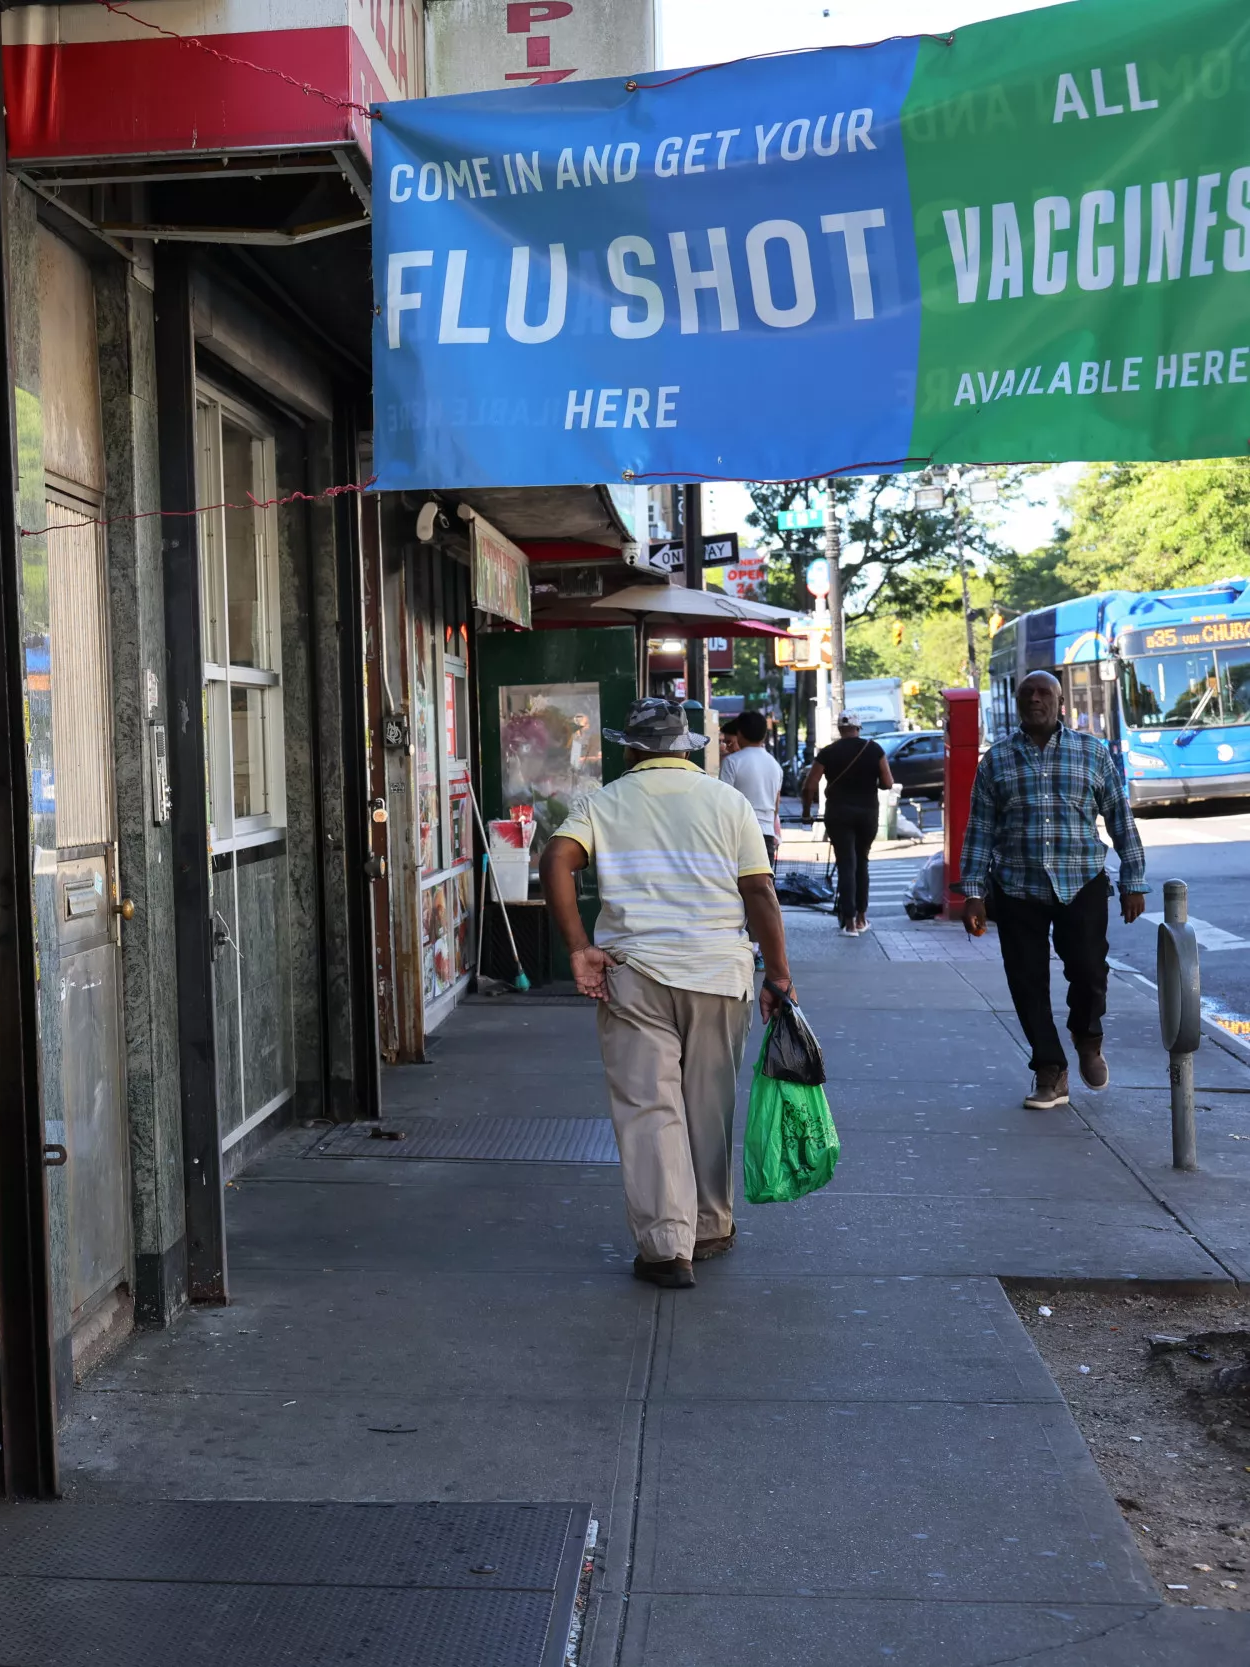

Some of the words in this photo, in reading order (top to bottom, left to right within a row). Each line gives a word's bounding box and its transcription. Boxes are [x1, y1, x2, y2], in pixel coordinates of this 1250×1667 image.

[1053, 62, 1158, 124] ALL
[390, 156, 497, 204] COME
[505, 150, 543, 196] IN
[557, 142, 640, 190] AND
[654, 129, 739, 178] GET
[756, 107, 877, 165] YOUR
[944, 165, 1250, 304] VACCINES
[386, 242, 567, 350] FLU
[607, 208, 887, 340] SHOT
[954, 356, 1143, 407] AVAILABLE
[1155, 347, 1250, 390] HERE
[564, 385, 680, 431] HERE
[662, 549, 684, 565] ON
[727, 570, 764, 581] OPEN
